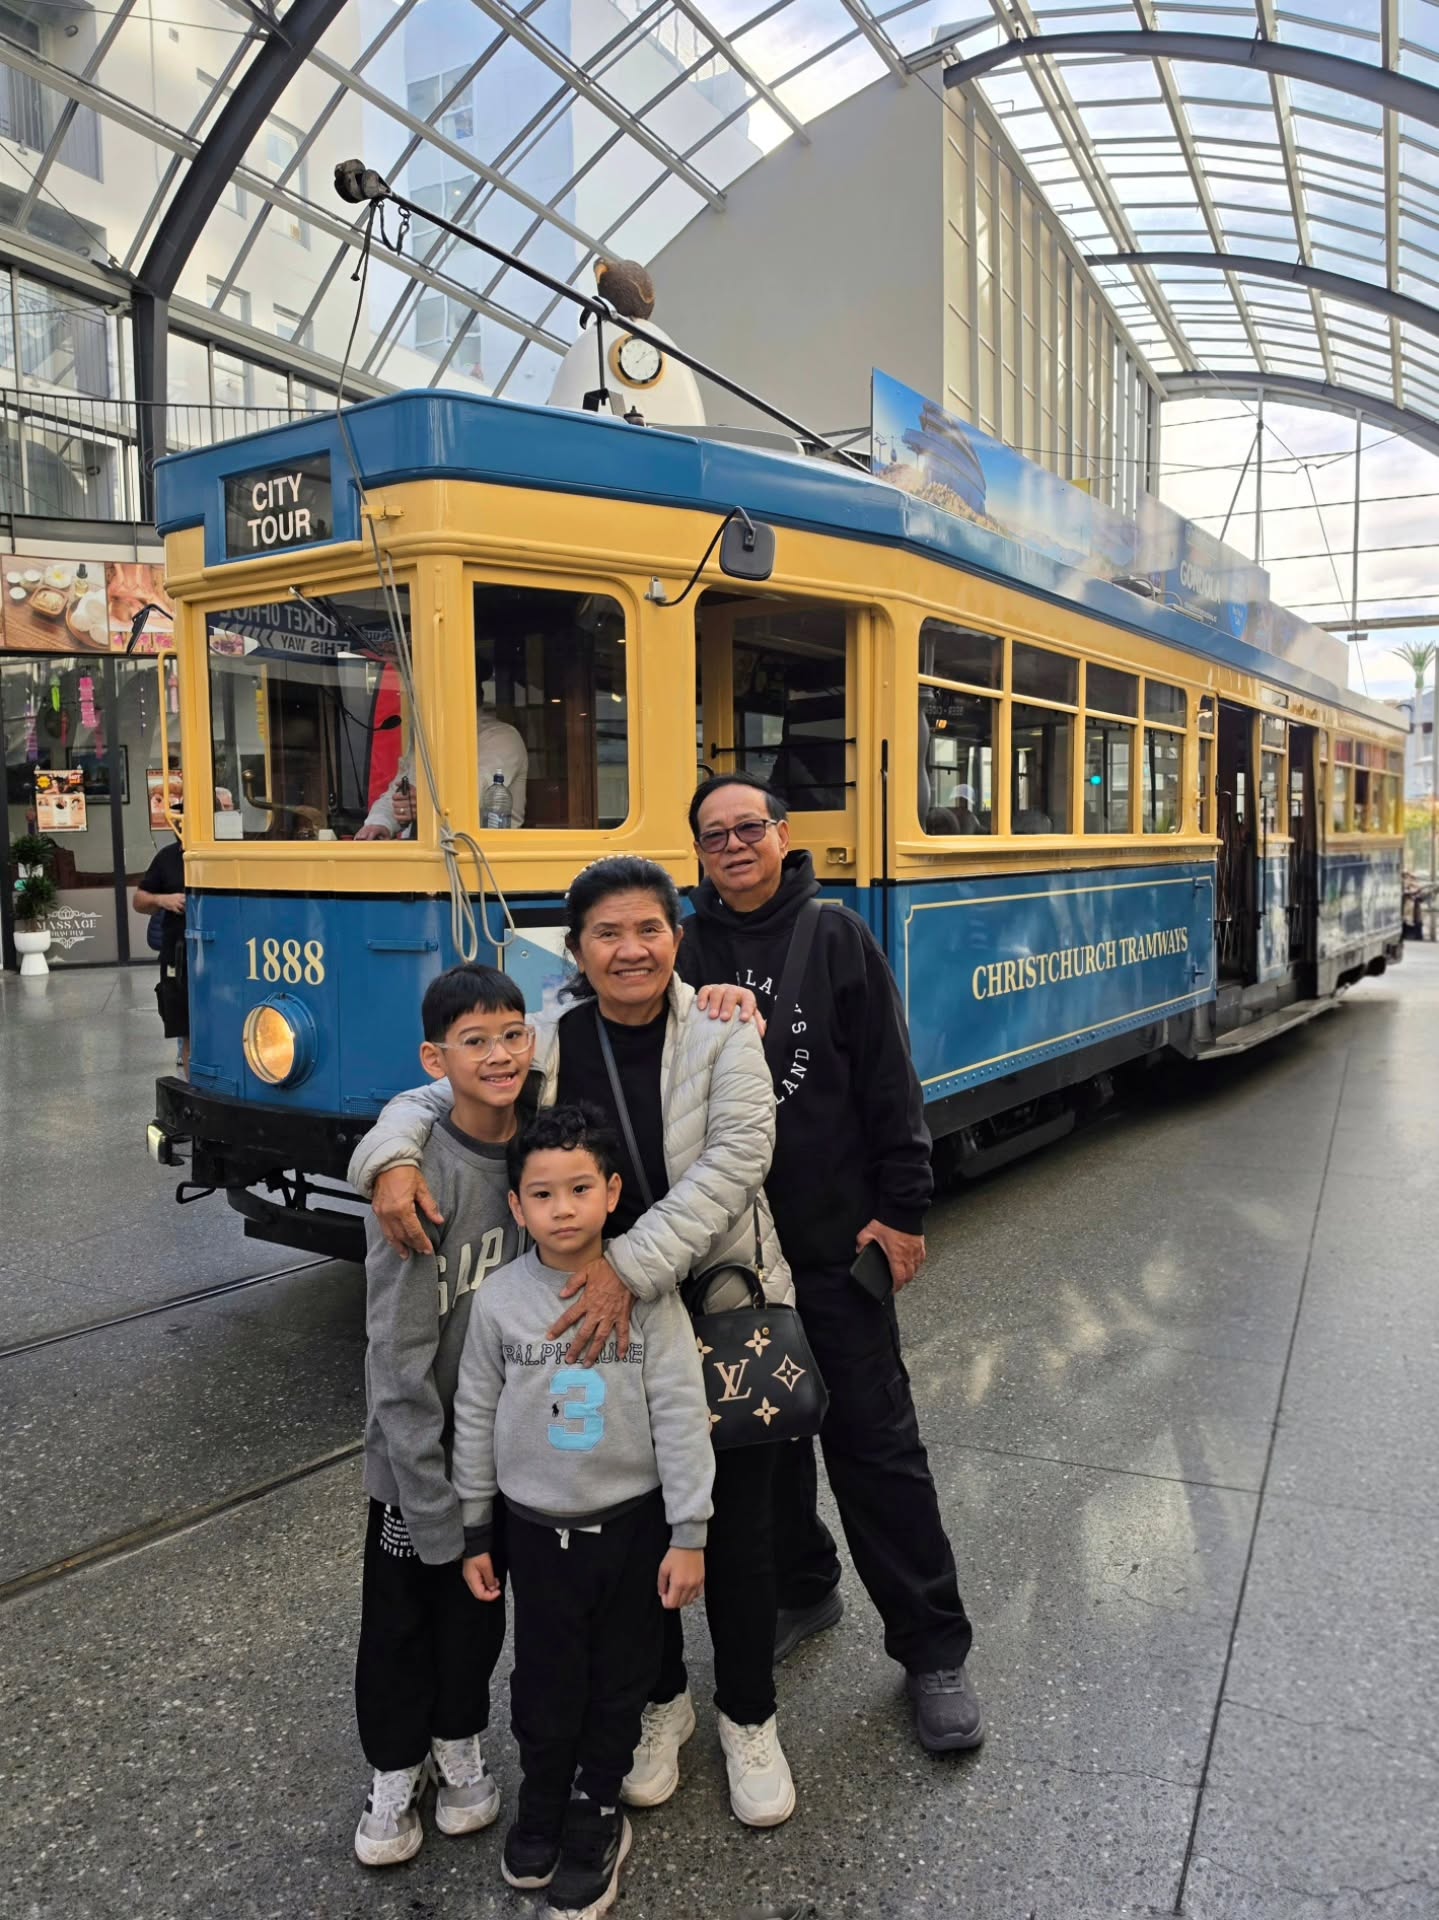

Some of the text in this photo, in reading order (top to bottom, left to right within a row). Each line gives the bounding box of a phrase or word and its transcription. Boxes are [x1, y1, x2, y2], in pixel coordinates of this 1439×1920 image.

[252, 473, 302, 511] CITY
[247, 508, 311, 547] TOUR
[1180, 560, 1221, 605] GONDOLA
[245, 937, 325, 985] 1888
[972, 926, 1188, 1000] CHRISTCHURCH TRAMWAYS
[502, 1343, 572, 1366] RALPH
[547, 1368, 608, 1452] 3
